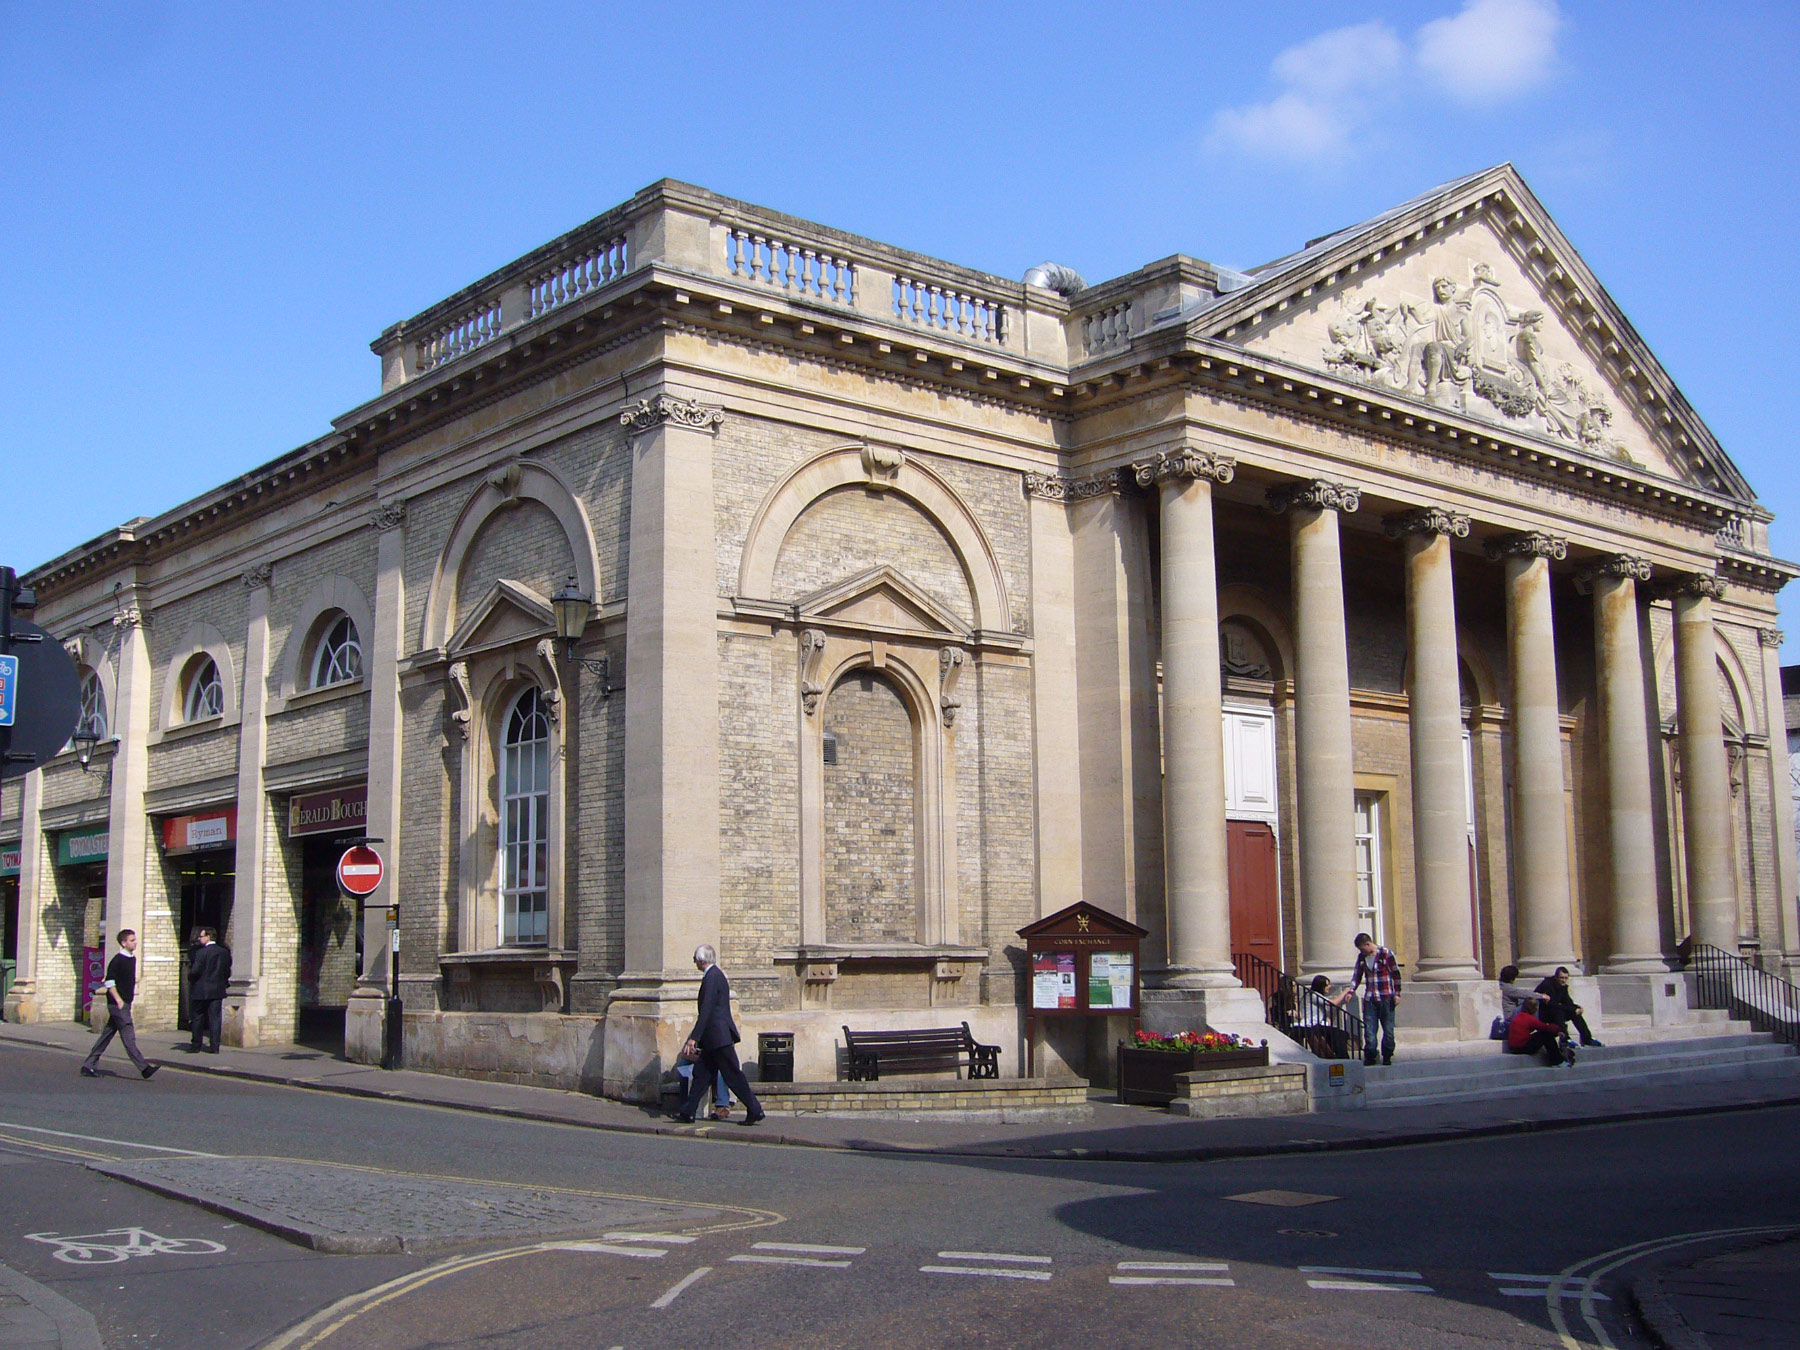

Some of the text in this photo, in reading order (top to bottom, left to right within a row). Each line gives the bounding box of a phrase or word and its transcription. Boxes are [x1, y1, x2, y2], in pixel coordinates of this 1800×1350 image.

[1336, 434, 1379, 458] EARTH
[291, 806, 330, 827] GERALD
[191, 828, 222, 840] Ryman
